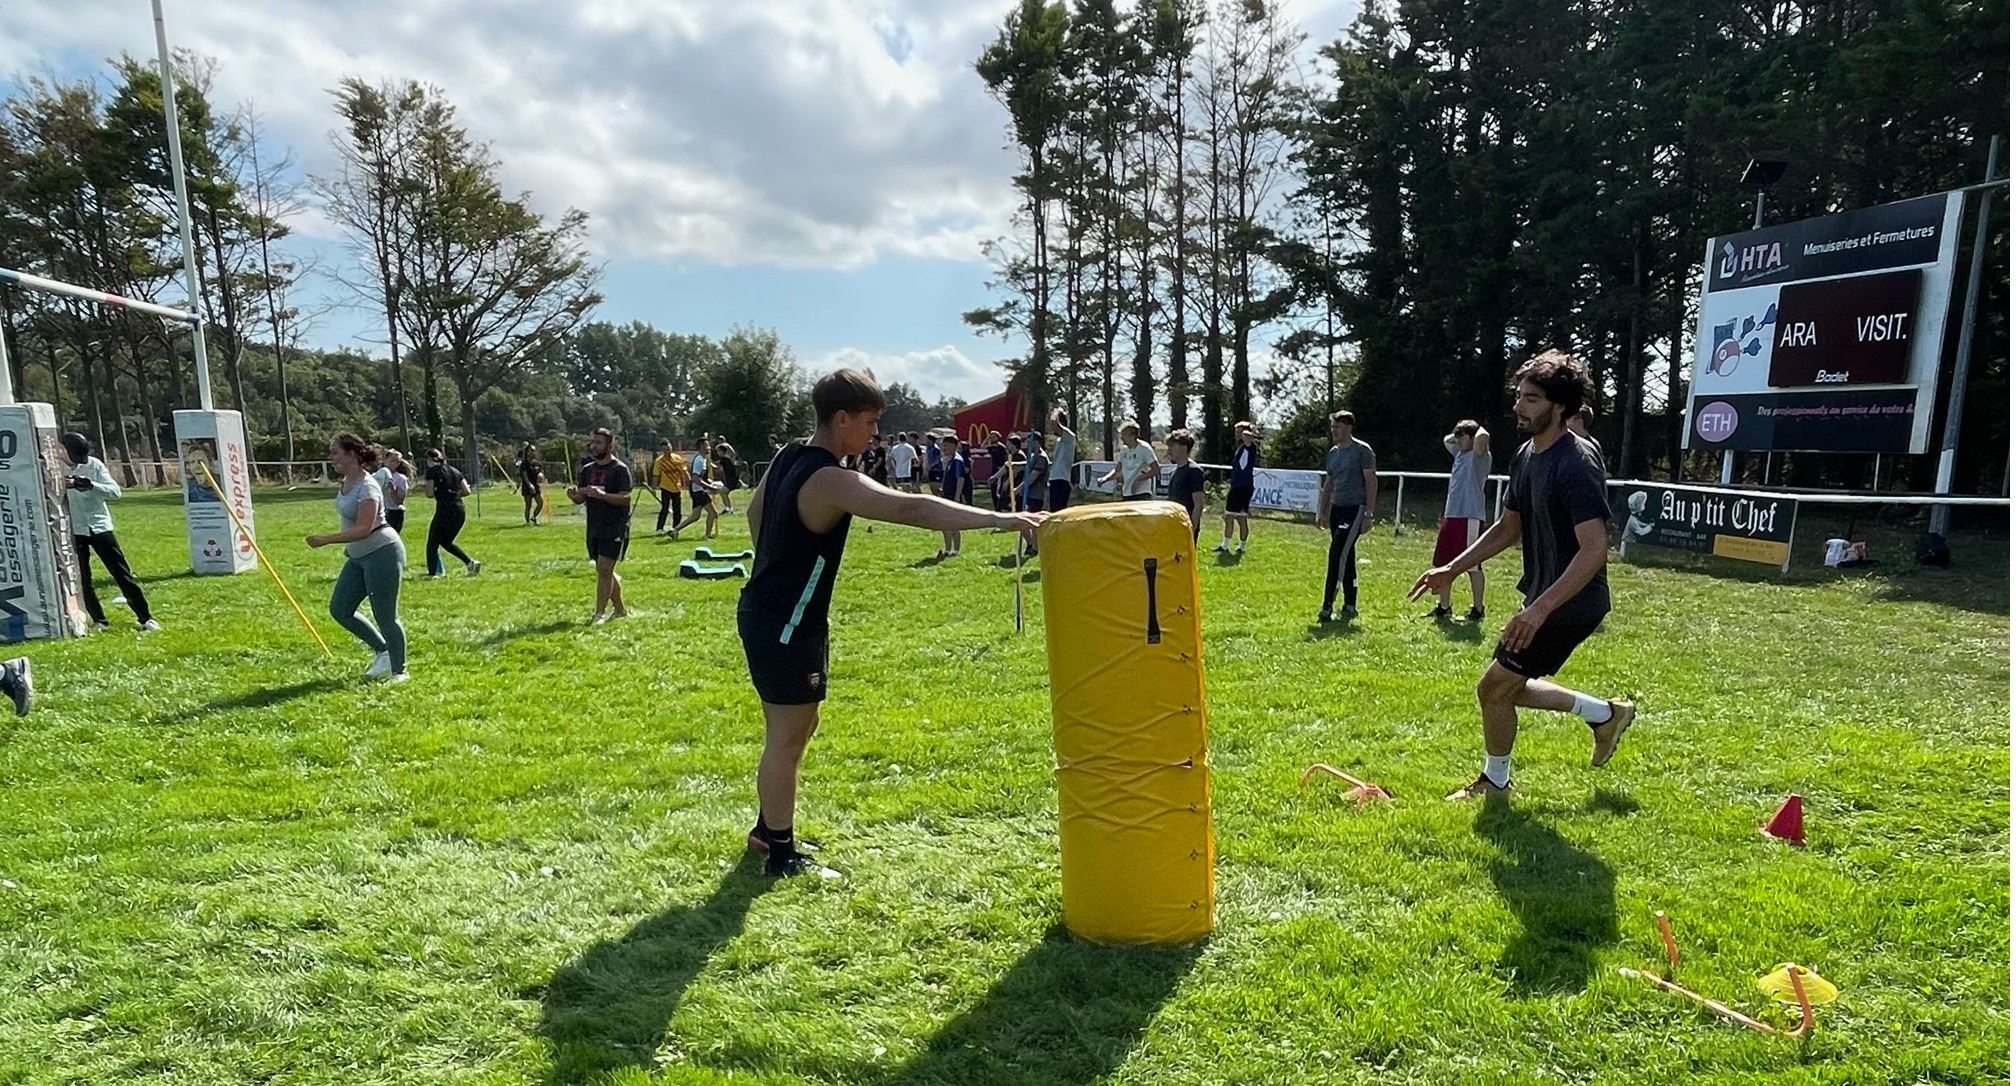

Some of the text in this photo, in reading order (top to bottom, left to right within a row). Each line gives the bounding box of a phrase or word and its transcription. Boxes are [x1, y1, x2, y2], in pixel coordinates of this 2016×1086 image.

[1803, 225, 1935, 257] Menuiseries et Fermetures
[1740, 242, 1782, 272] HTA
[1779, 321, 1816, 348] ARA
[1857, 313, 1908, 342] VISIT.
[1701, 413, 1731, 432] ETH
[227, 442, 246, 520] express
[1659, 490, 1778, 536] Au p'tit Chef
